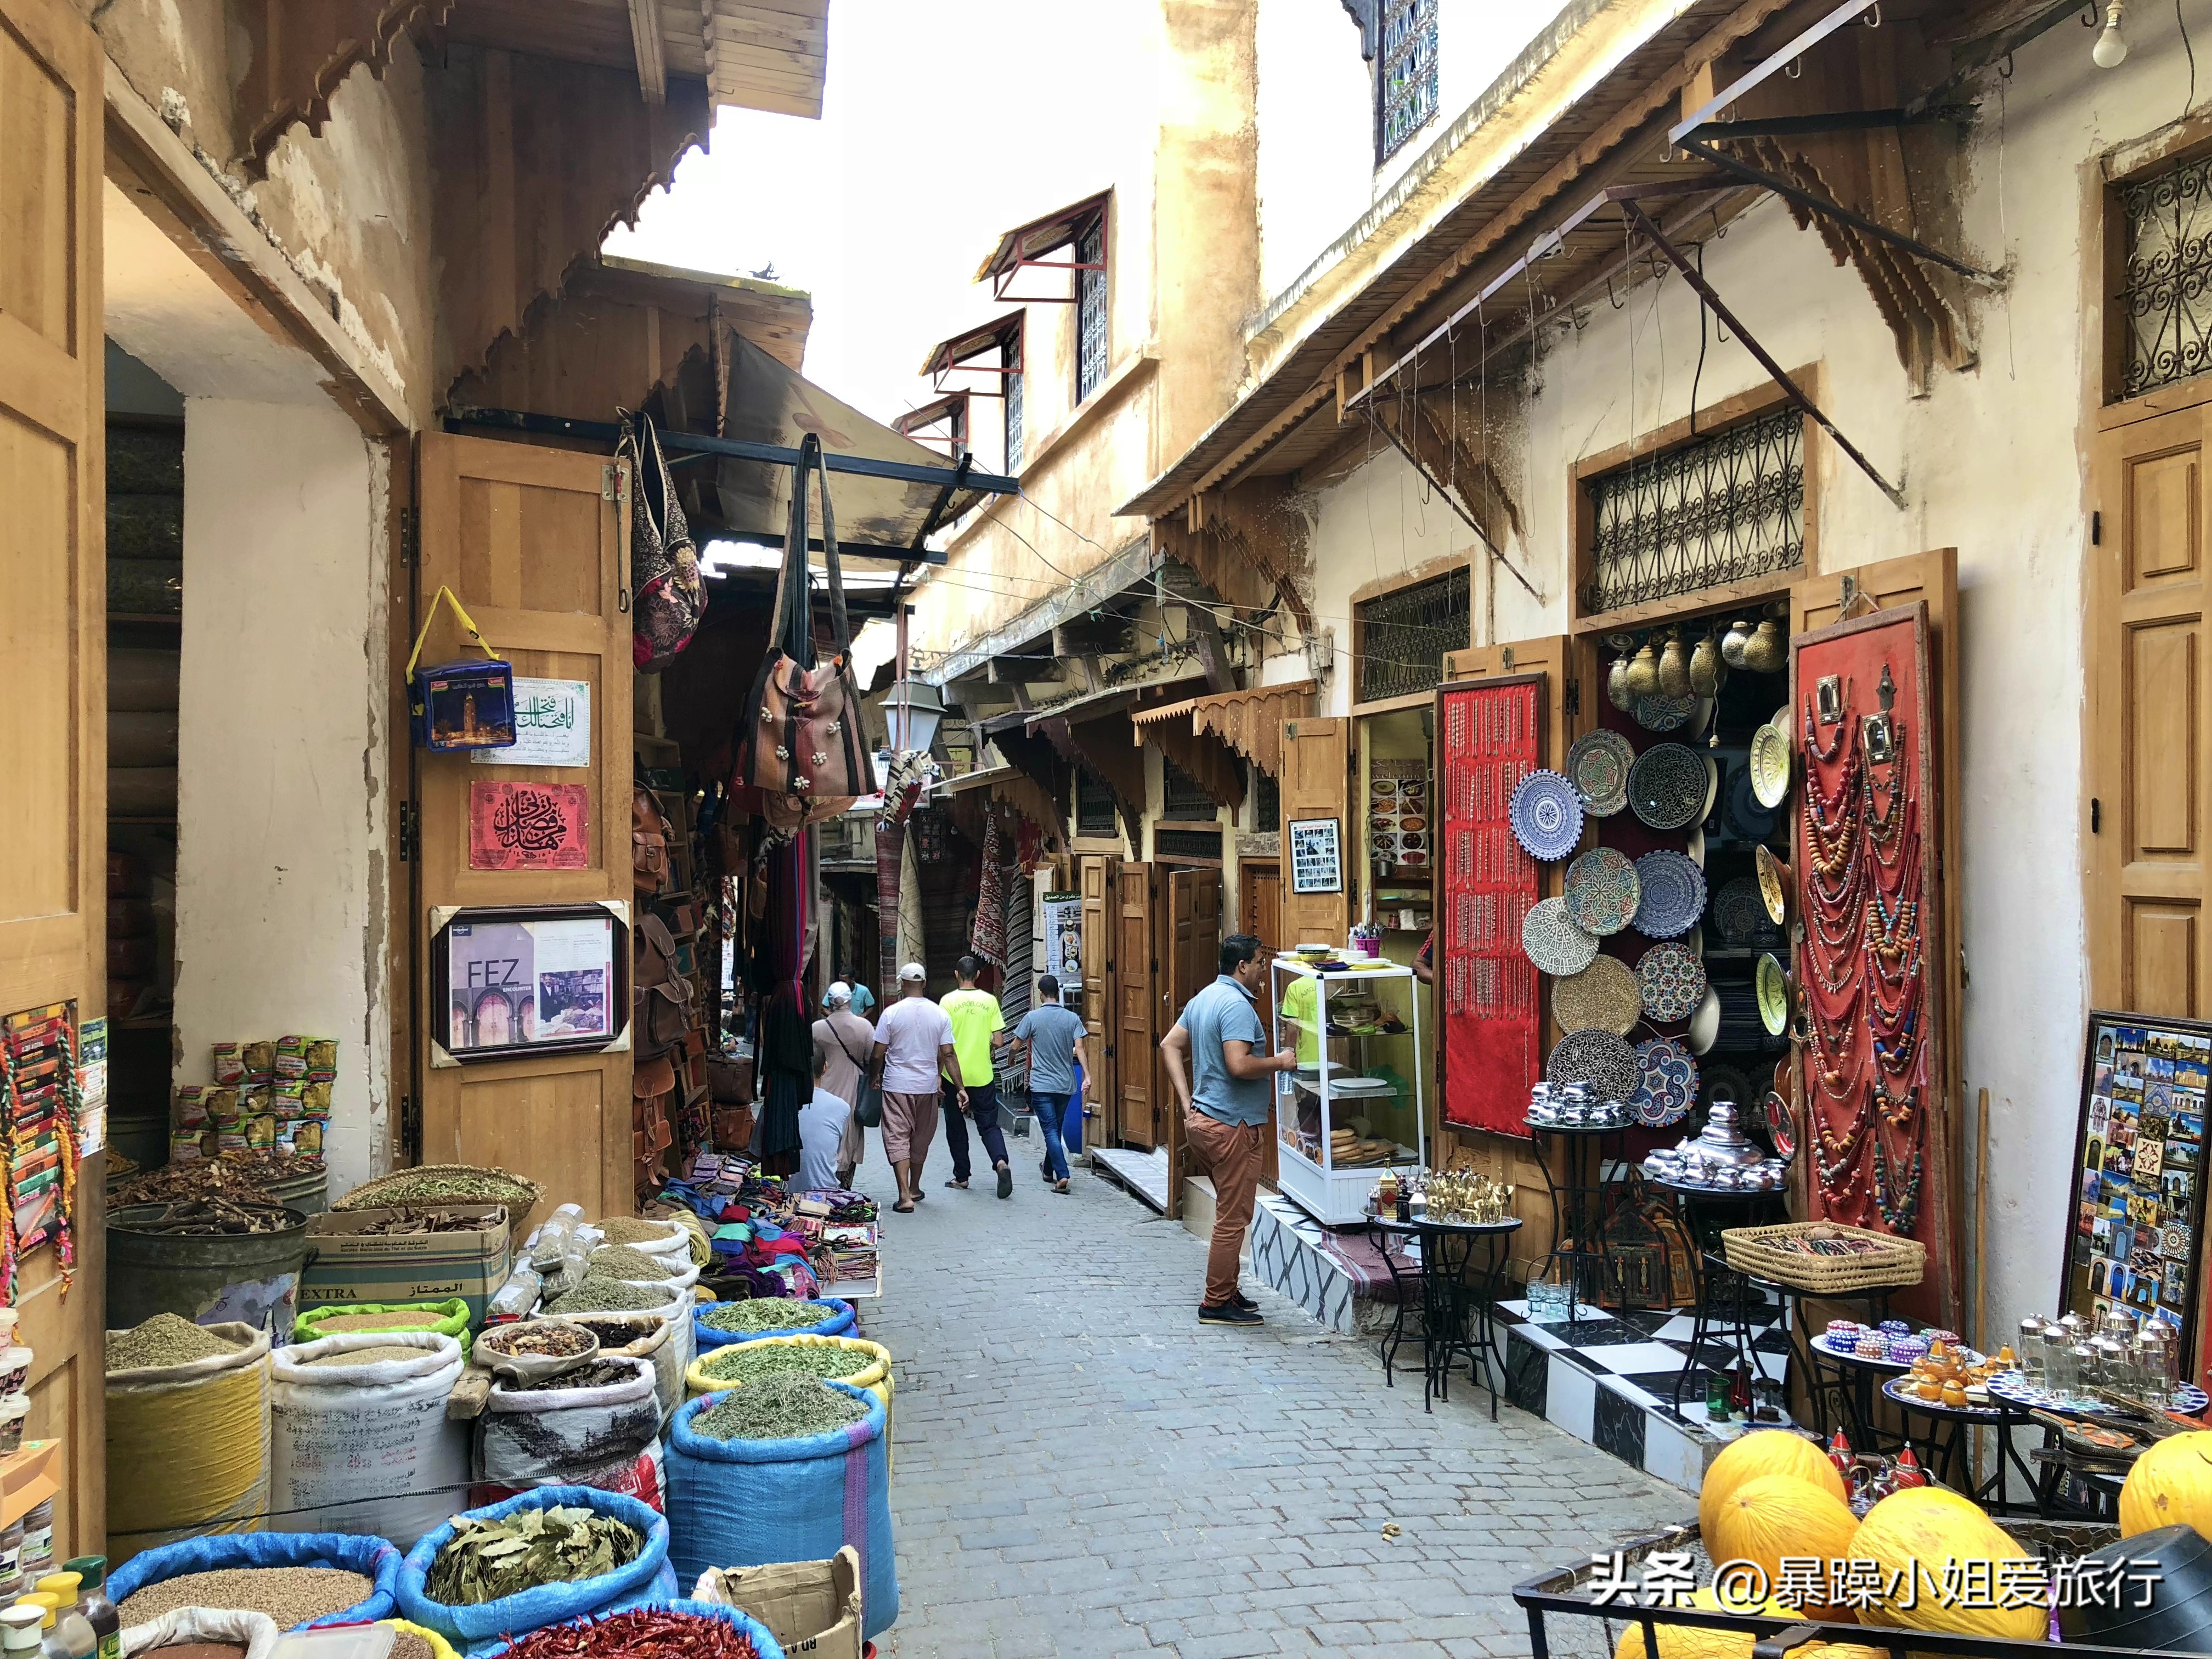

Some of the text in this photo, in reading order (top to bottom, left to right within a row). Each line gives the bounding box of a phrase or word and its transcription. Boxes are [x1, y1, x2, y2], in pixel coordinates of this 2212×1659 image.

[469, 958, 520, 988] FEZ
[954, 1001, 989, 1012] BARCELONA
[301, 1288, 357, 1299] EXTRA
[409, 1283, 463, 1296] الممتاز
